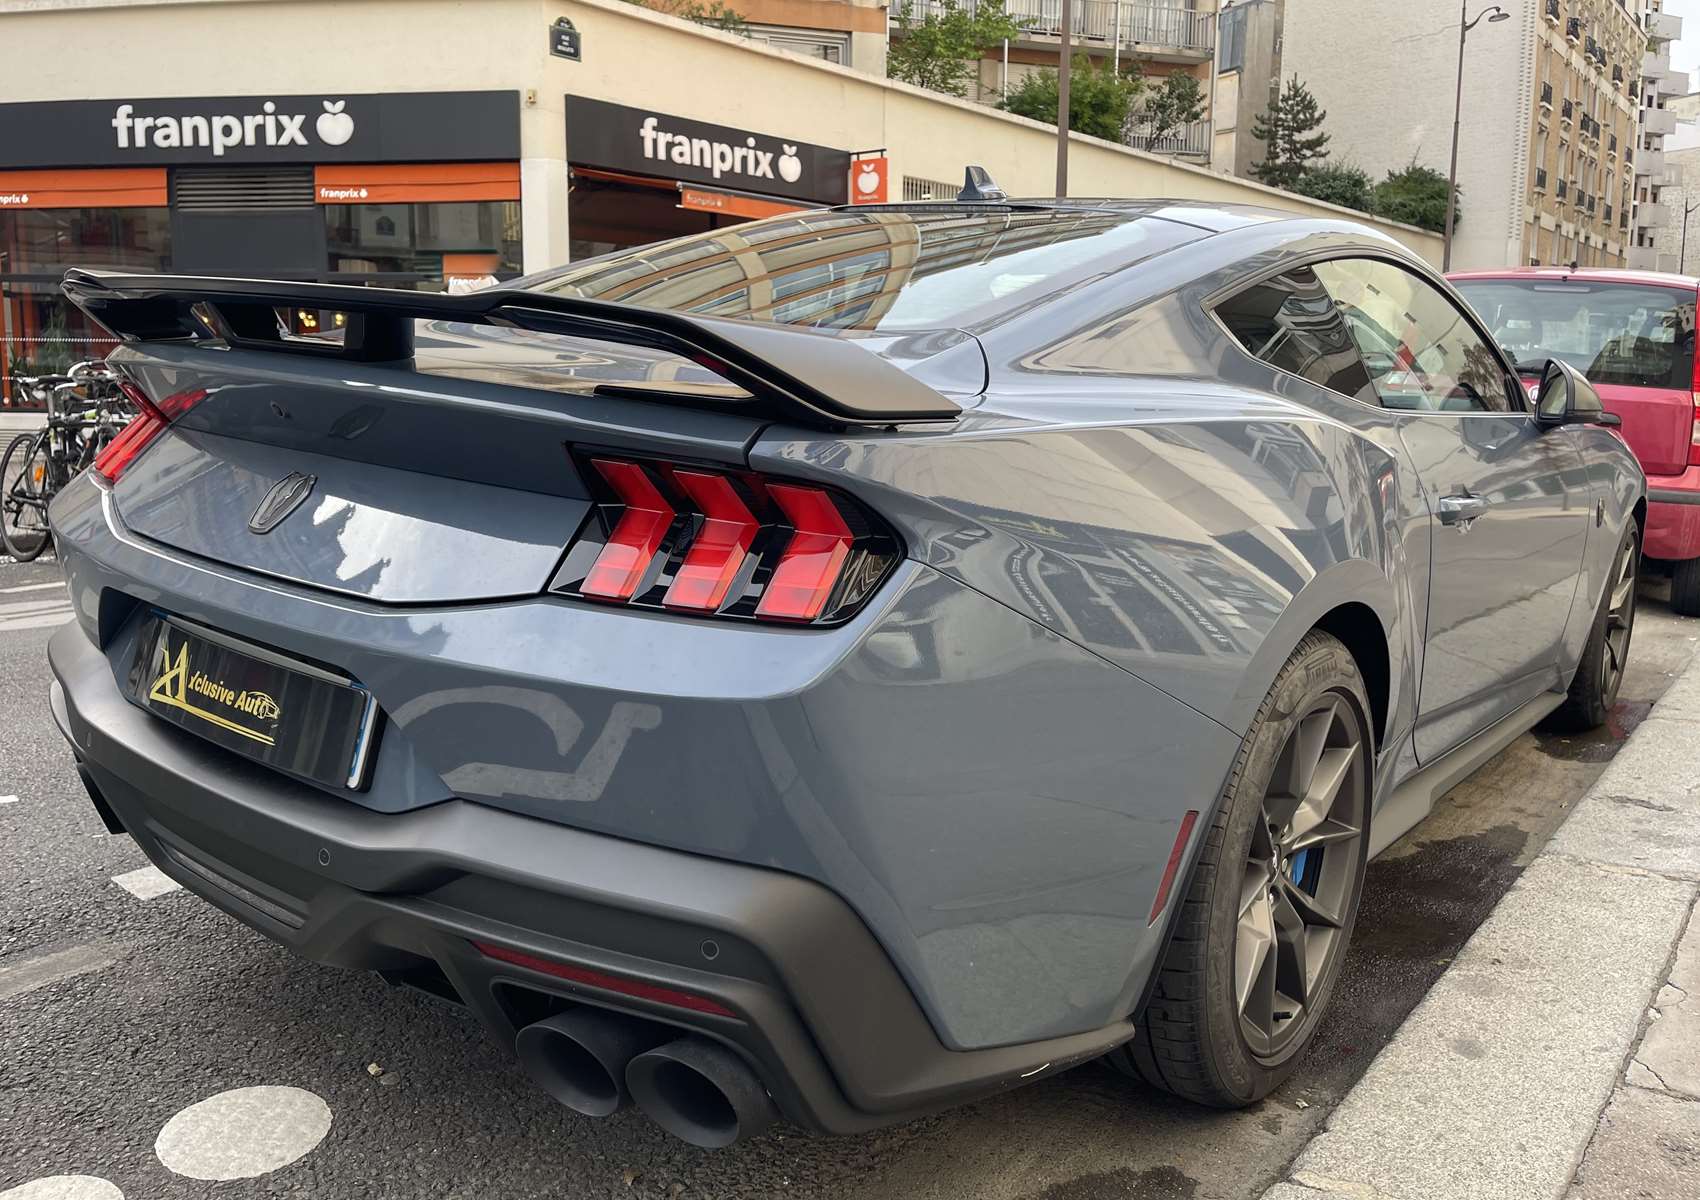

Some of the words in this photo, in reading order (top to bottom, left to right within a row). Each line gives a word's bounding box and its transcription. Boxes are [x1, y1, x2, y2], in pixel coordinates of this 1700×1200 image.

[112, 101, 309, 156] franprix
[640, 117, 775, 179] franprix
[320, 188, 360, 200] franprix
